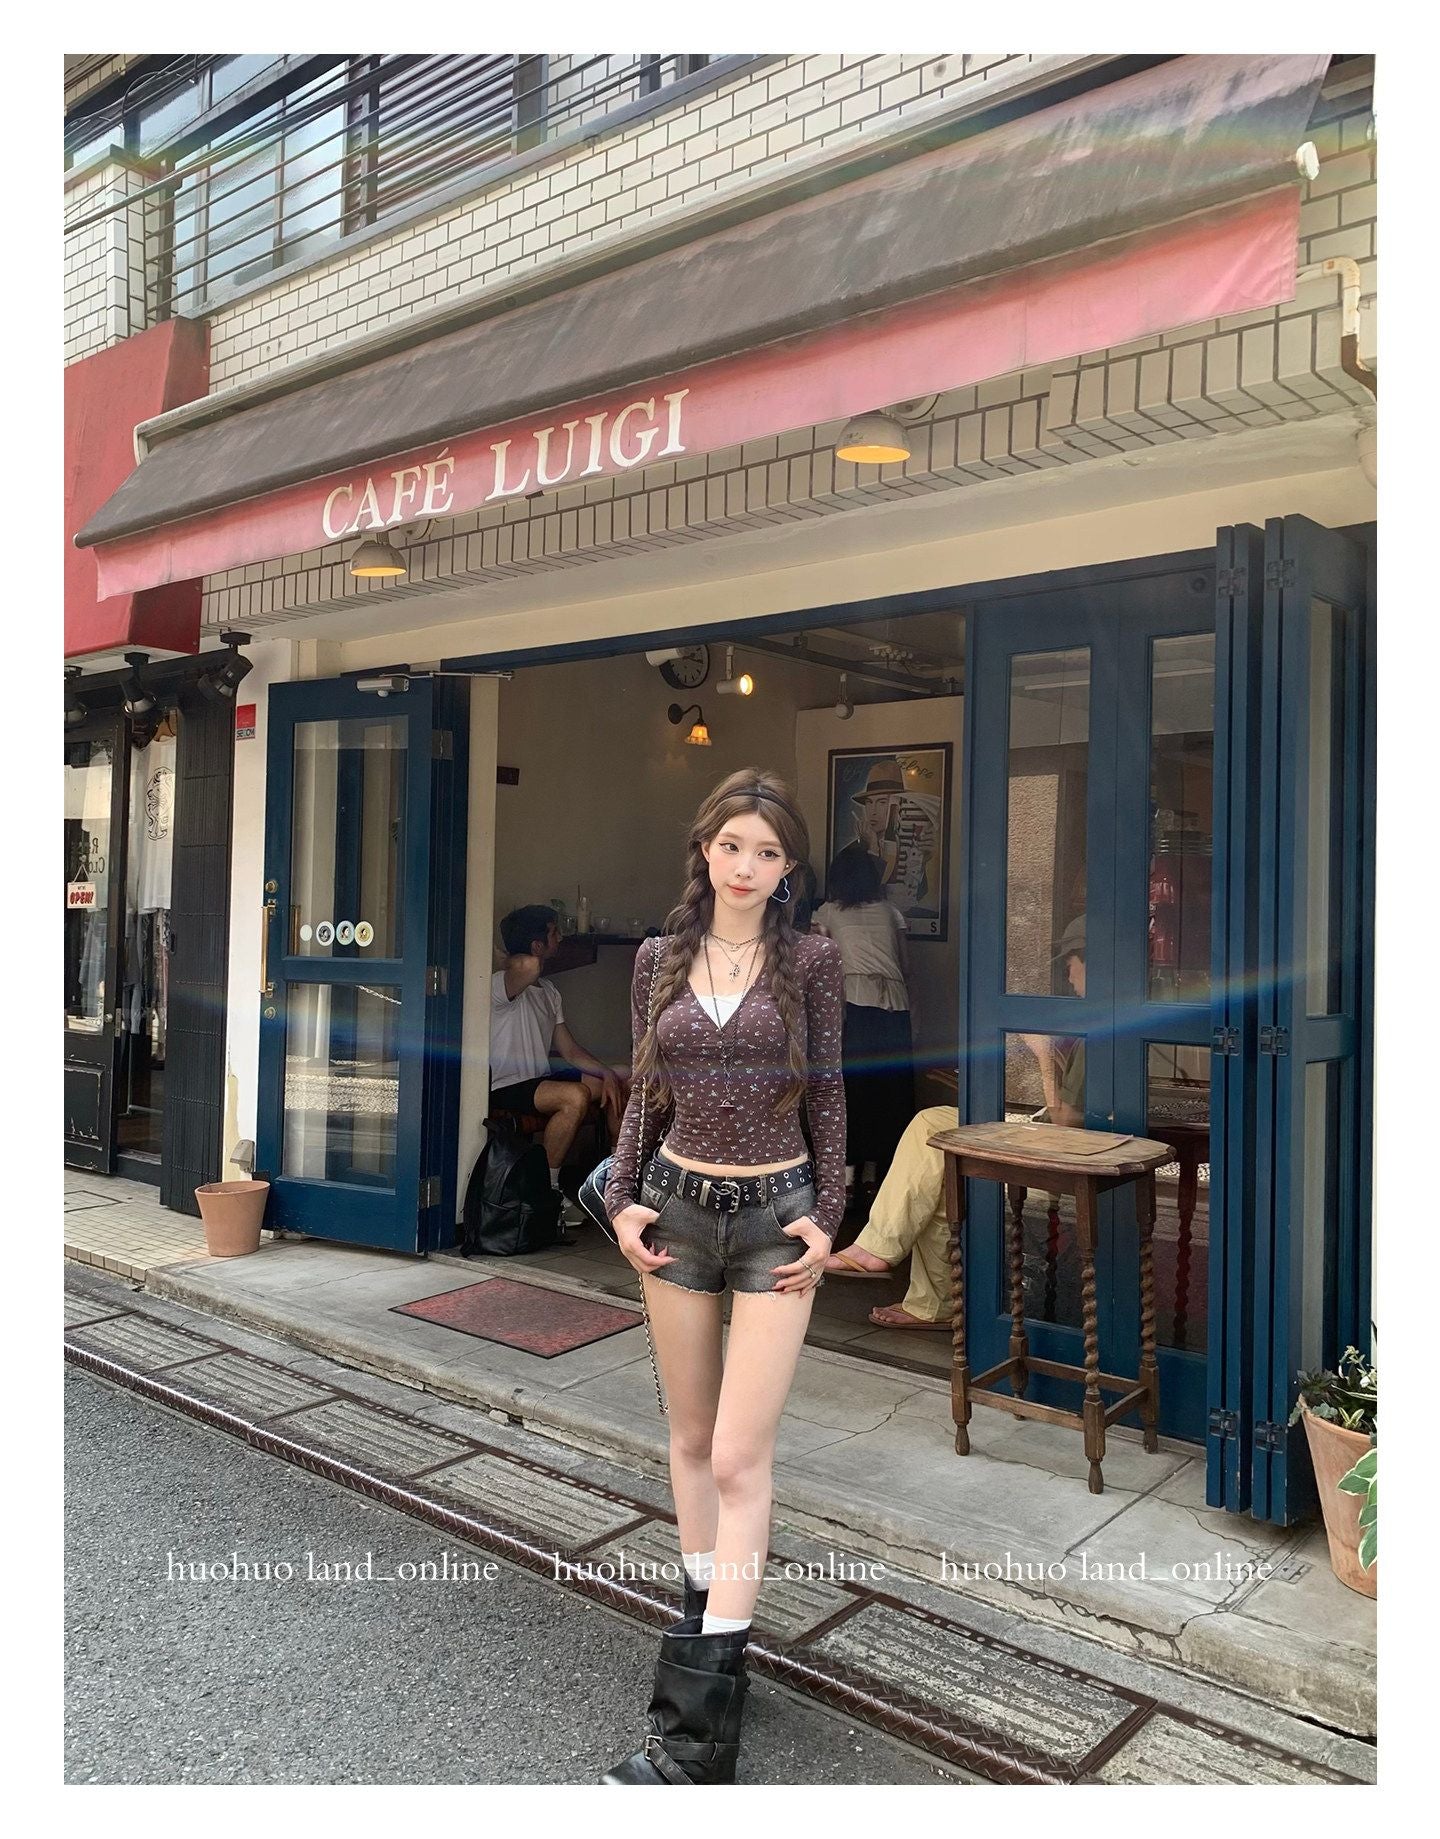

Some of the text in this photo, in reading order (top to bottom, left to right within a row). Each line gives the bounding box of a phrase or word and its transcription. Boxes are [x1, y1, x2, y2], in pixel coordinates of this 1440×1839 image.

[321, 388, 690, 540] CAFÉ LUIGI
[236, 728, 255, 738] SEOM
